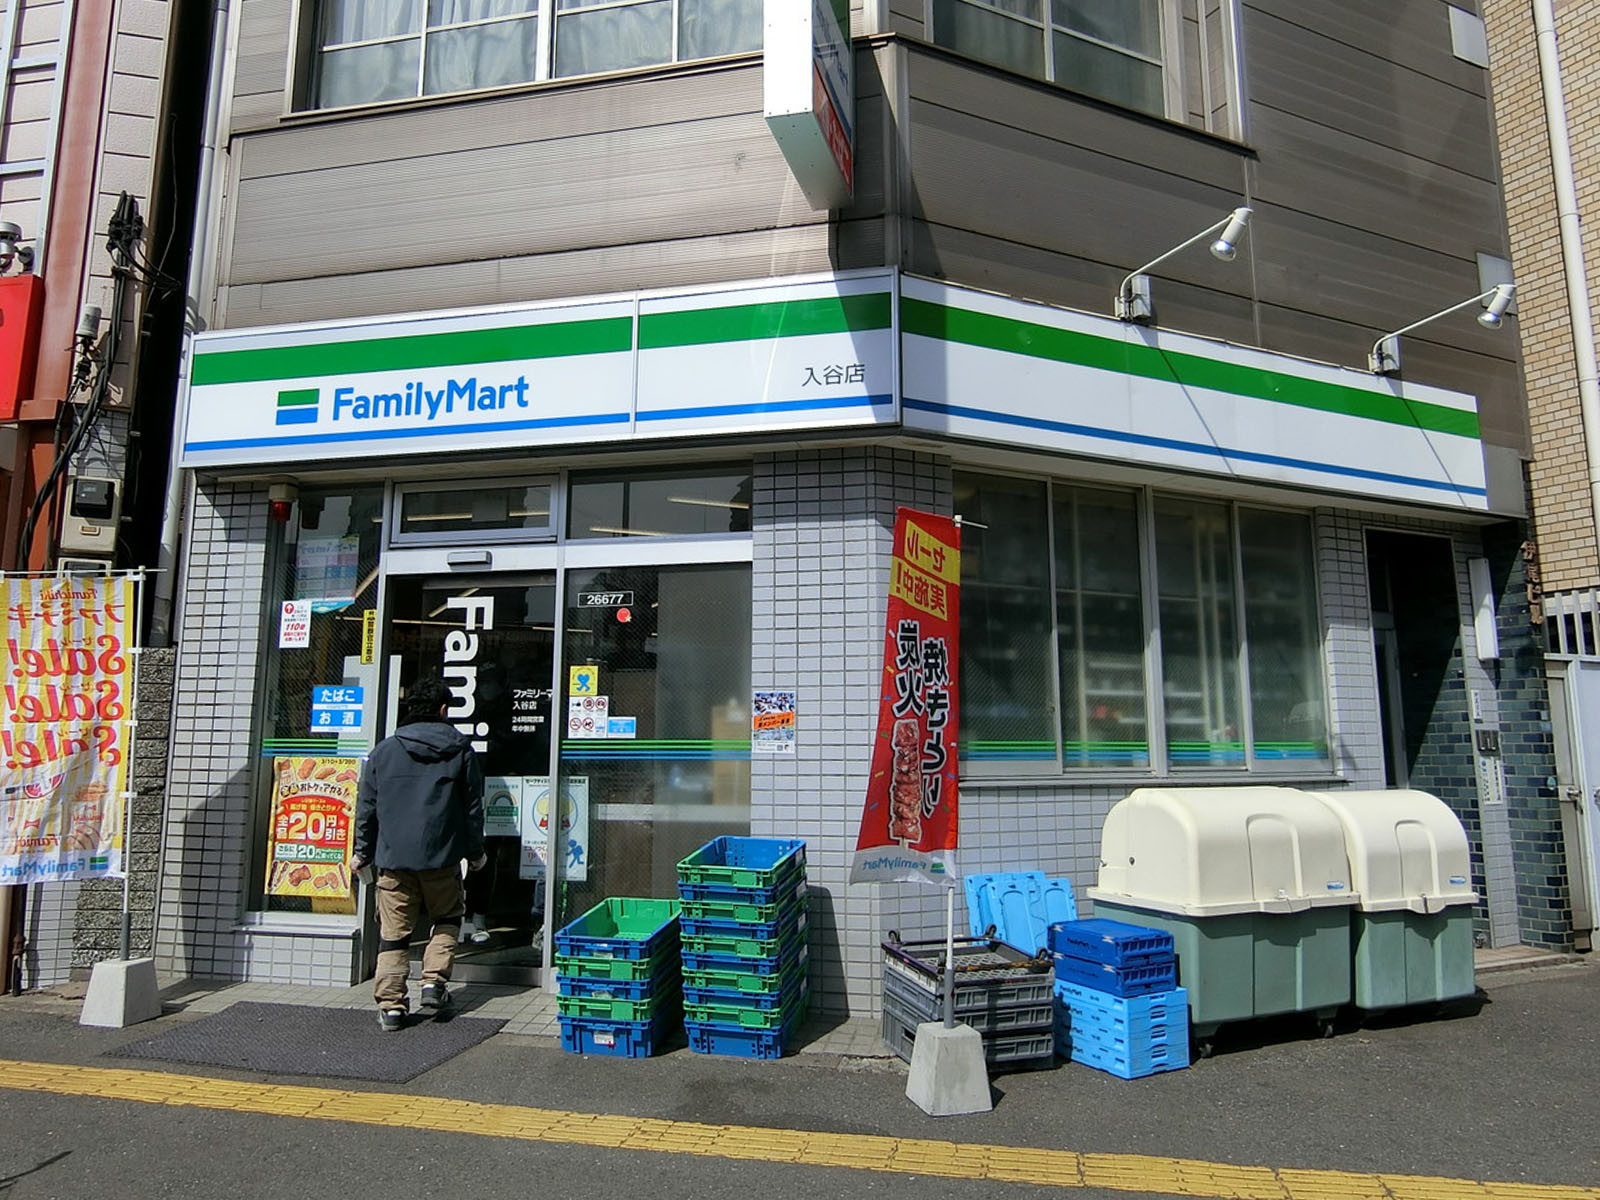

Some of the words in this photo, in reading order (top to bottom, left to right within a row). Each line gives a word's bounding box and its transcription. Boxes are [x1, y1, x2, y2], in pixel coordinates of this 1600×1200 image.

[802, 363, 865, 387] 入谷店
[333, 376, 529, 420] FamilyMart
[586, 593, 624, 605] 26677
[321, 689, 355, 702] たばこ
[512, 701, 537, 710] 入谷店
